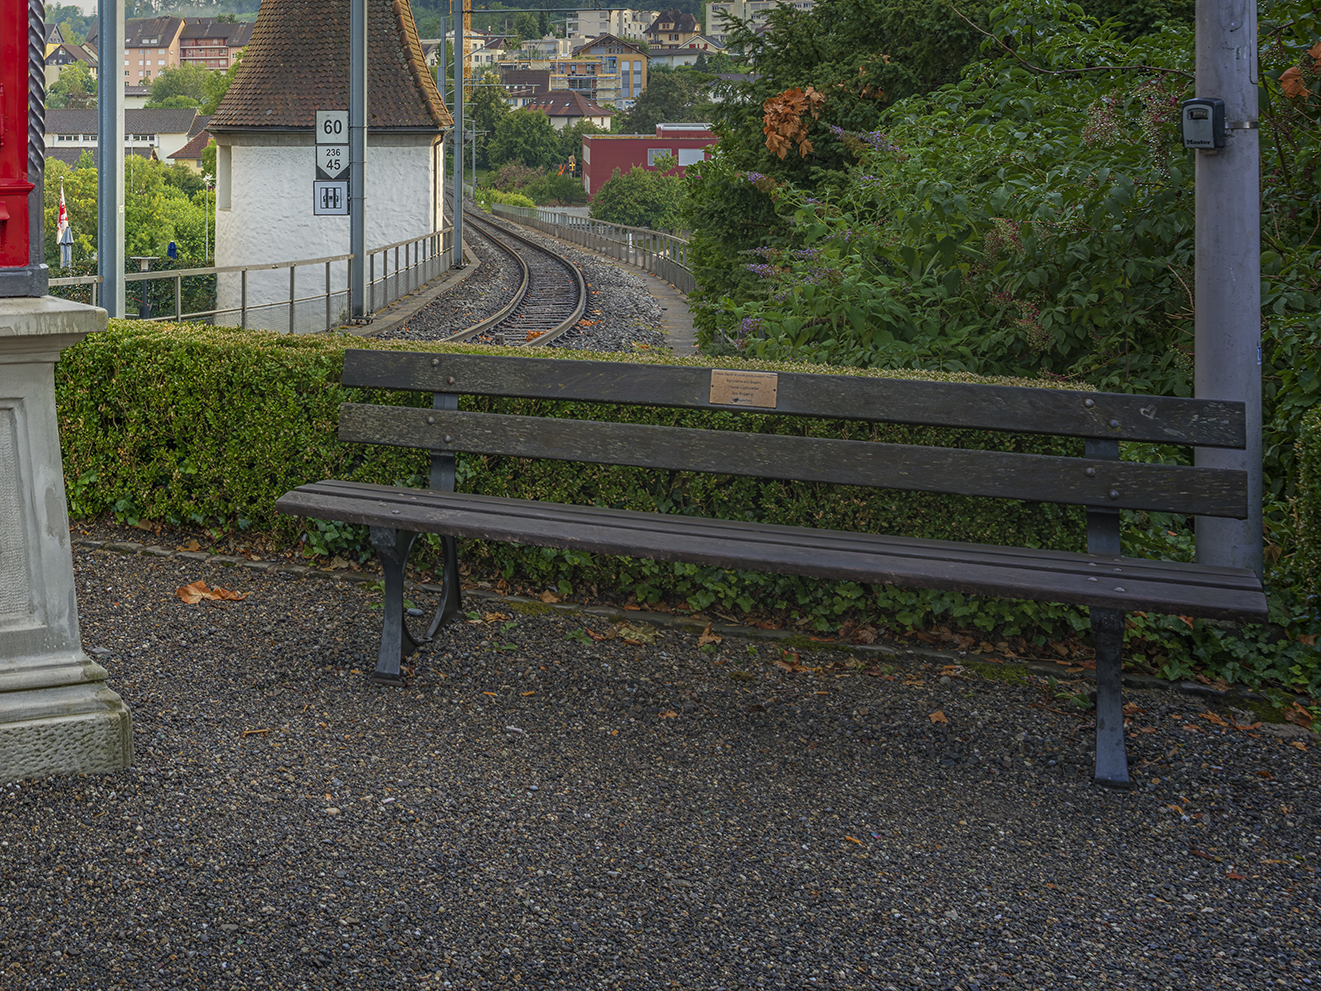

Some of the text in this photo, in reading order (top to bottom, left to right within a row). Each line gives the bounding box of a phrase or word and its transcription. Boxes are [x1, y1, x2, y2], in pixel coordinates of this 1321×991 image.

[323, 119, 342, 134] 60
[325, 148, 341, 157] 236
[326, 159, 341, 170] 45
